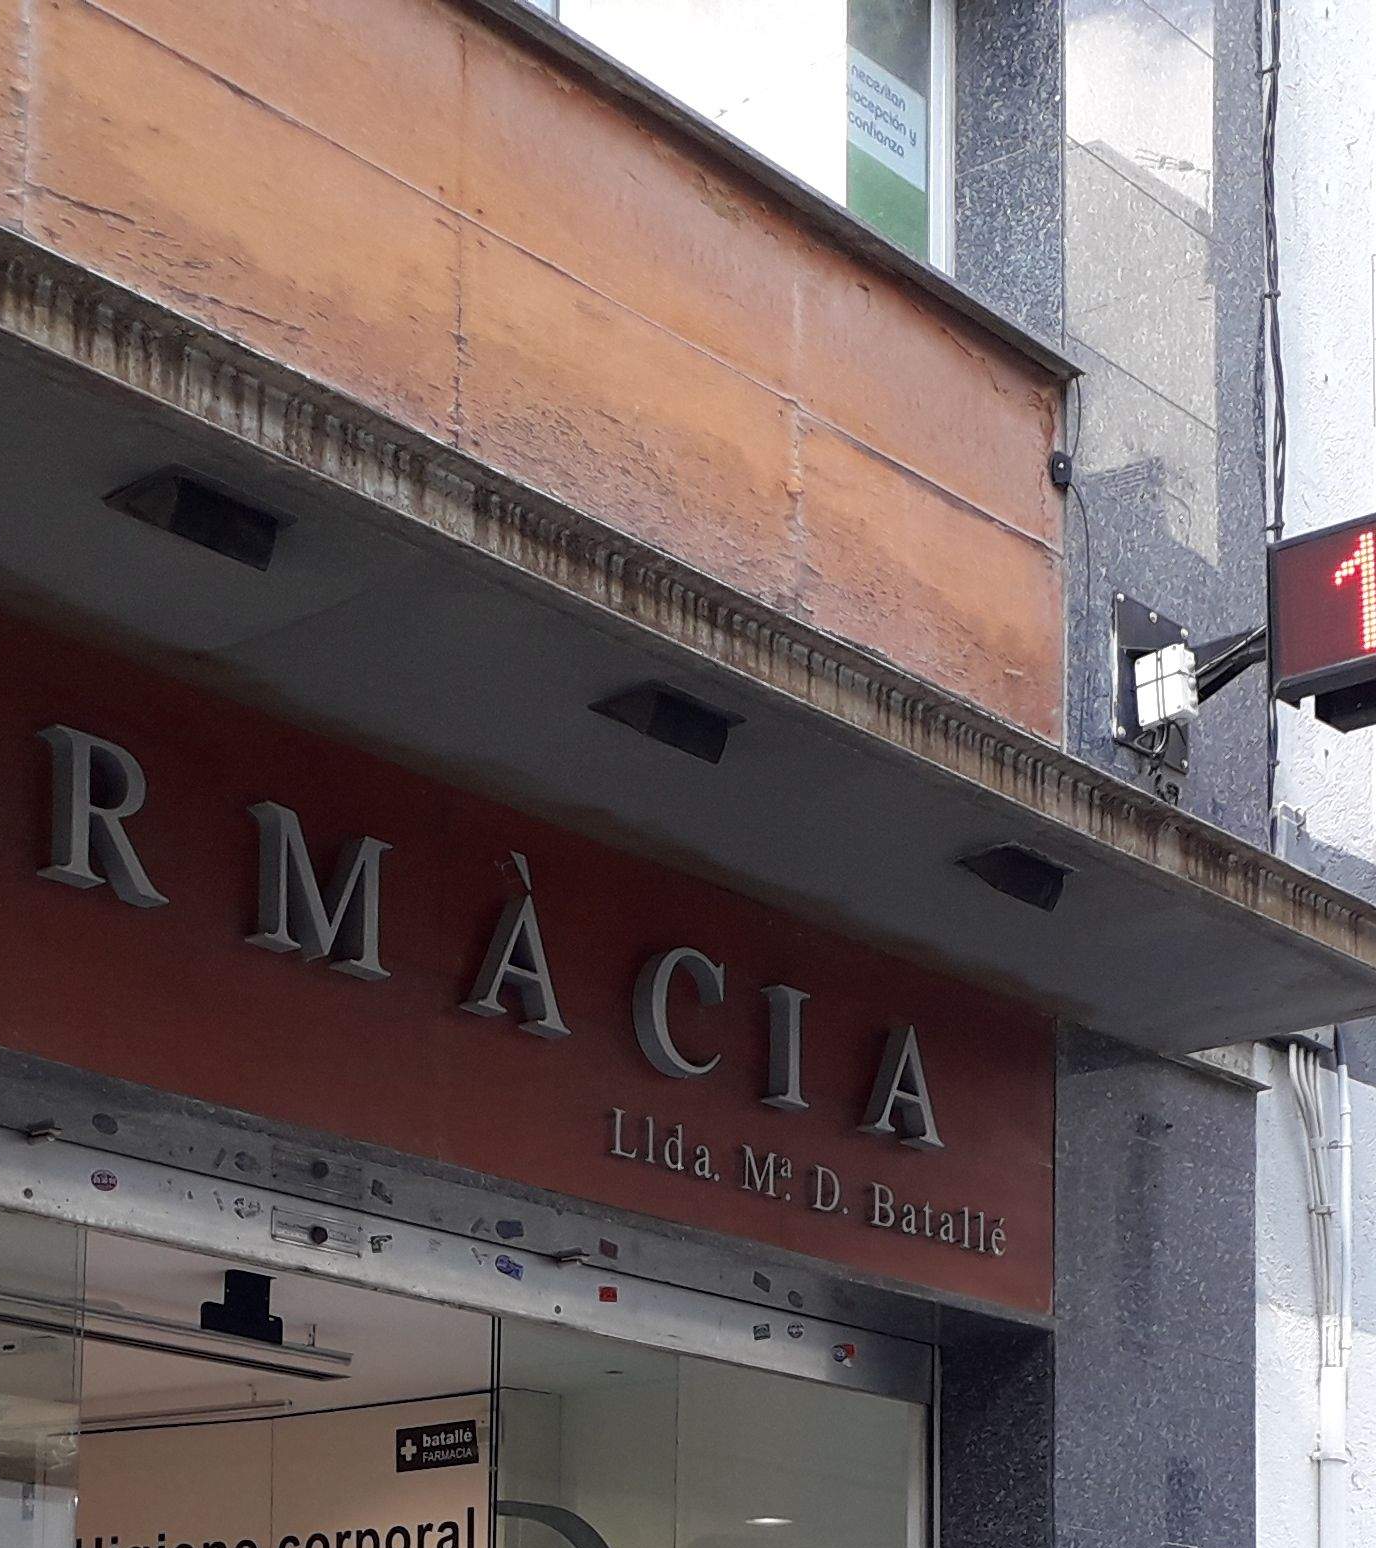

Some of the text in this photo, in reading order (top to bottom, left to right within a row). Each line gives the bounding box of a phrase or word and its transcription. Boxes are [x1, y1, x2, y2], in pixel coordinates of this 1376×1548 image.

[610, 1106, 722, 1183] Llda.
[812, 1164, 850, 1216] D.
[869, 1181, 1007, 1257] Batallé
[422, 1447, 473, 1463] FARMACIA
